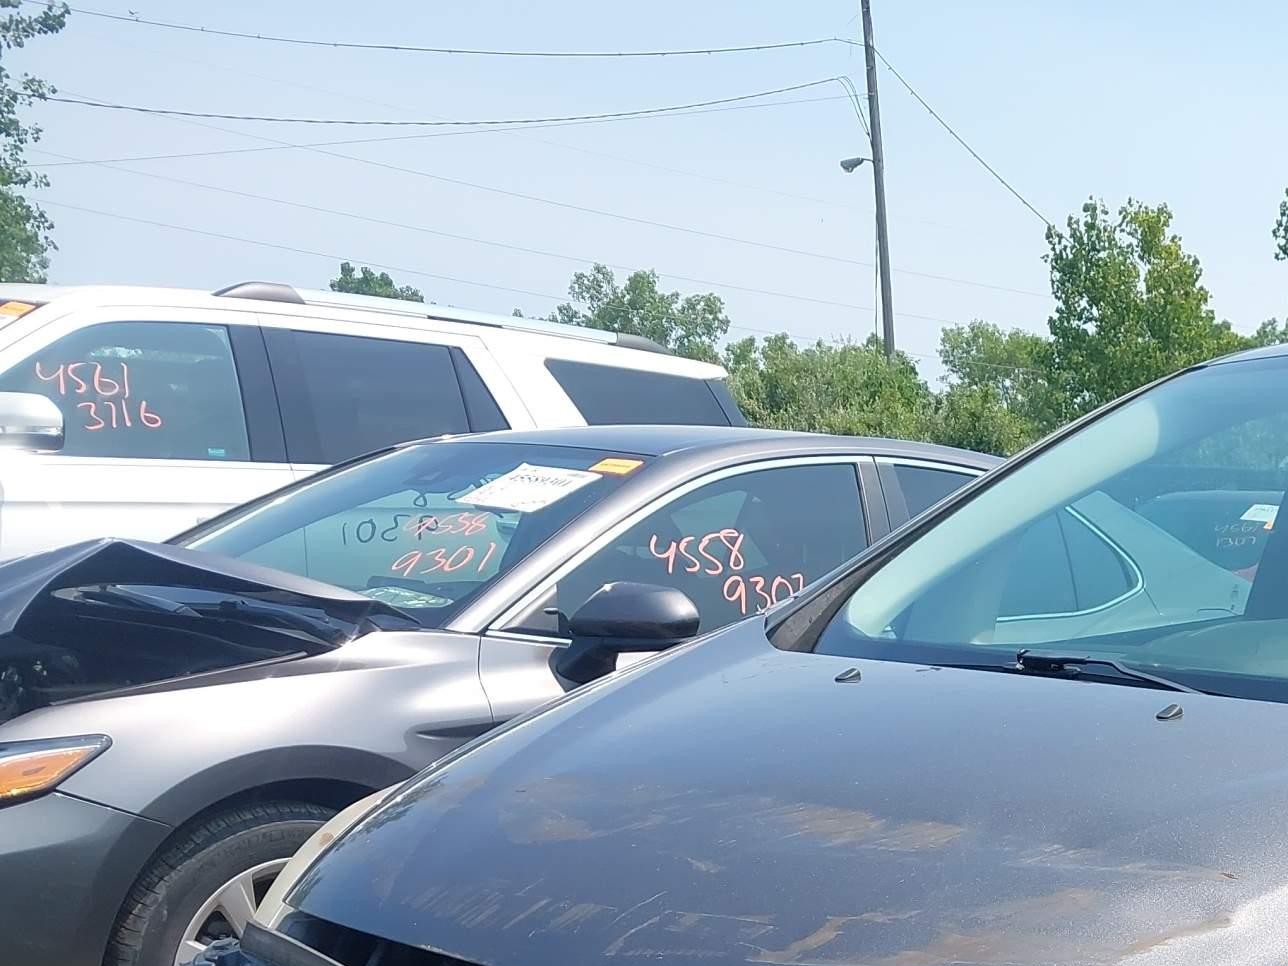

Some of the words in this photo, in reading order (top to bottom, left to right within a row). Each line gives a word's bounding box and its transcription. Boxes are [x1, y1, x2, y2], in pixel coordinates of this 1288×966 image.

[36, 361, 129, 398] 4561
[77, 399, 162, 430] 3716
[391, 542, 496, 577] 9301
[649, 528, 744, 574] 4558
